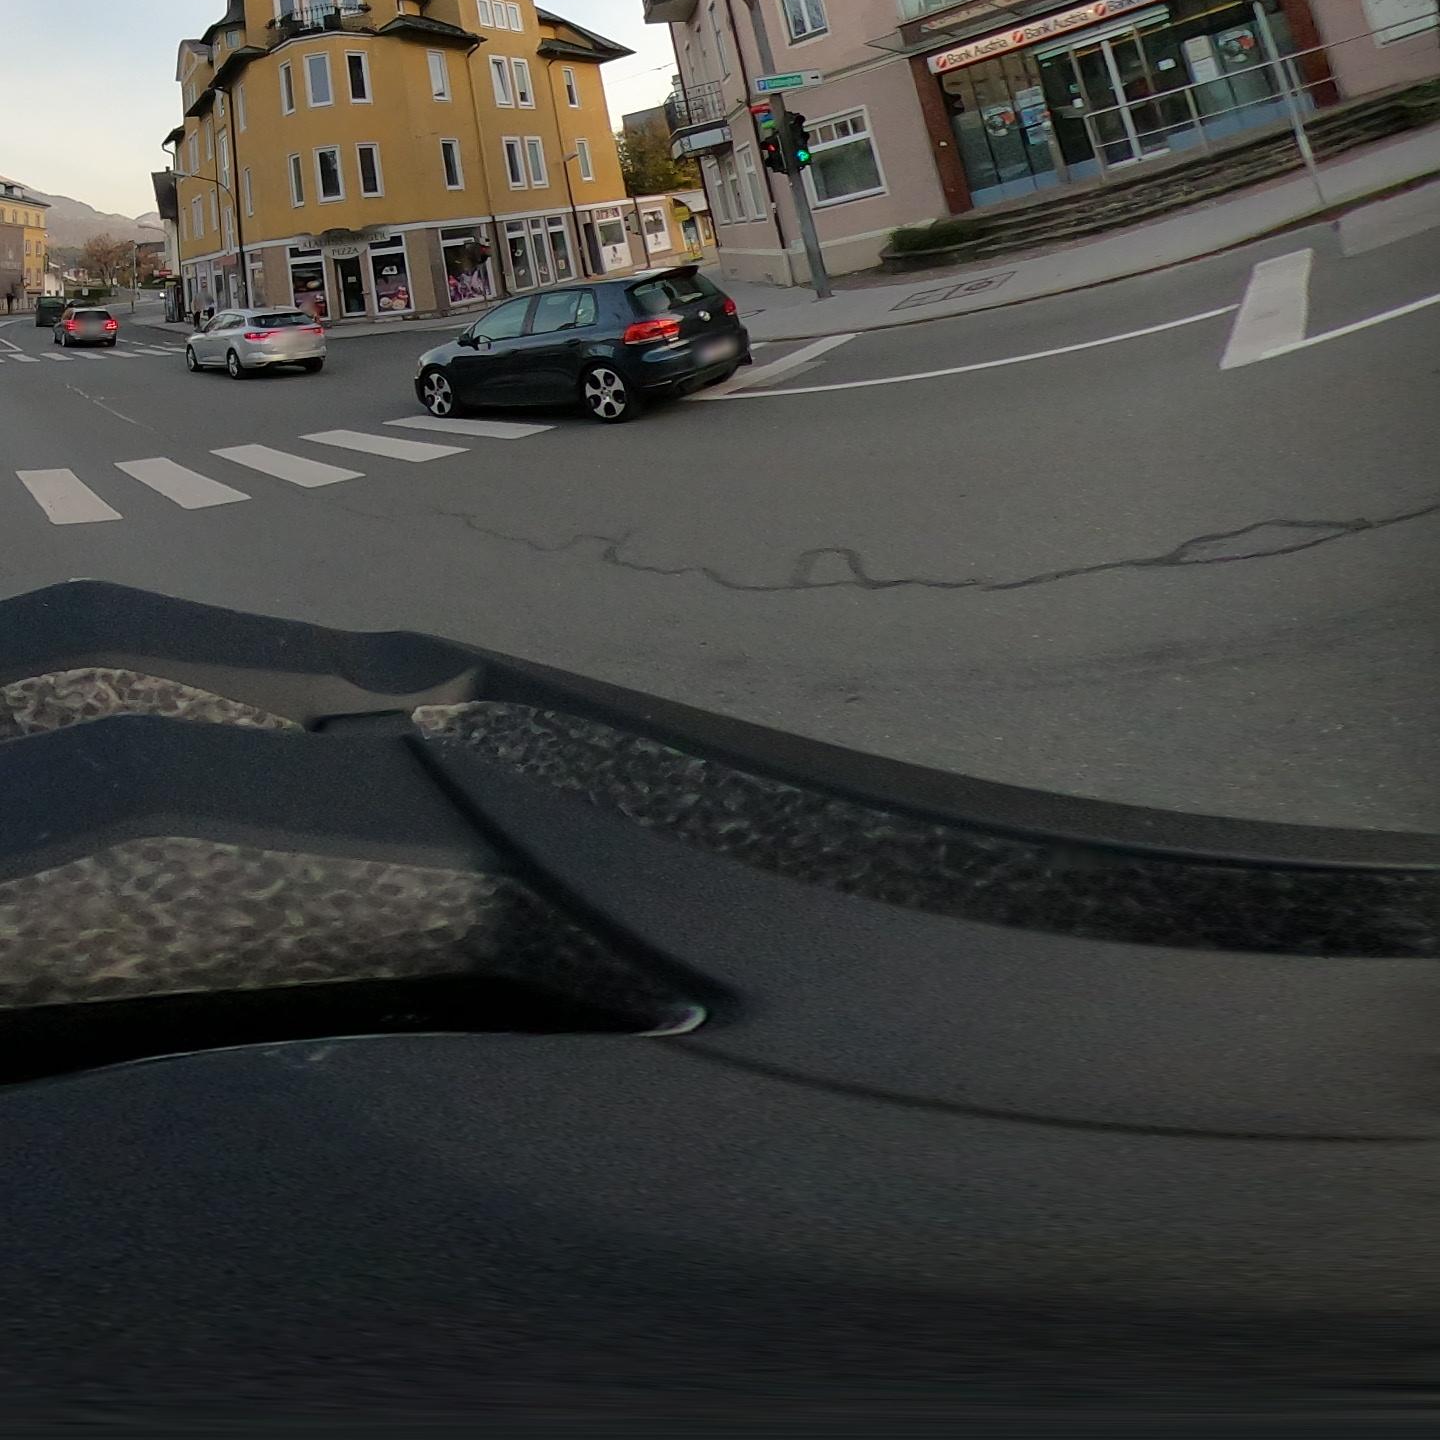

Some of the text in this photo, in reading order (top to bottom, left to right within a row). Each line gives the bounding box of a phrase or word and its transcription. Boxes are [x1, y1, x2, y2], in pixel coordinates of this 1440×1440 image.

[1024, 11, 1090, 40] Bank Austria
[946, 37, 1009, 65] Bank Austria
[332, 246, 360, 257] PIZZA
